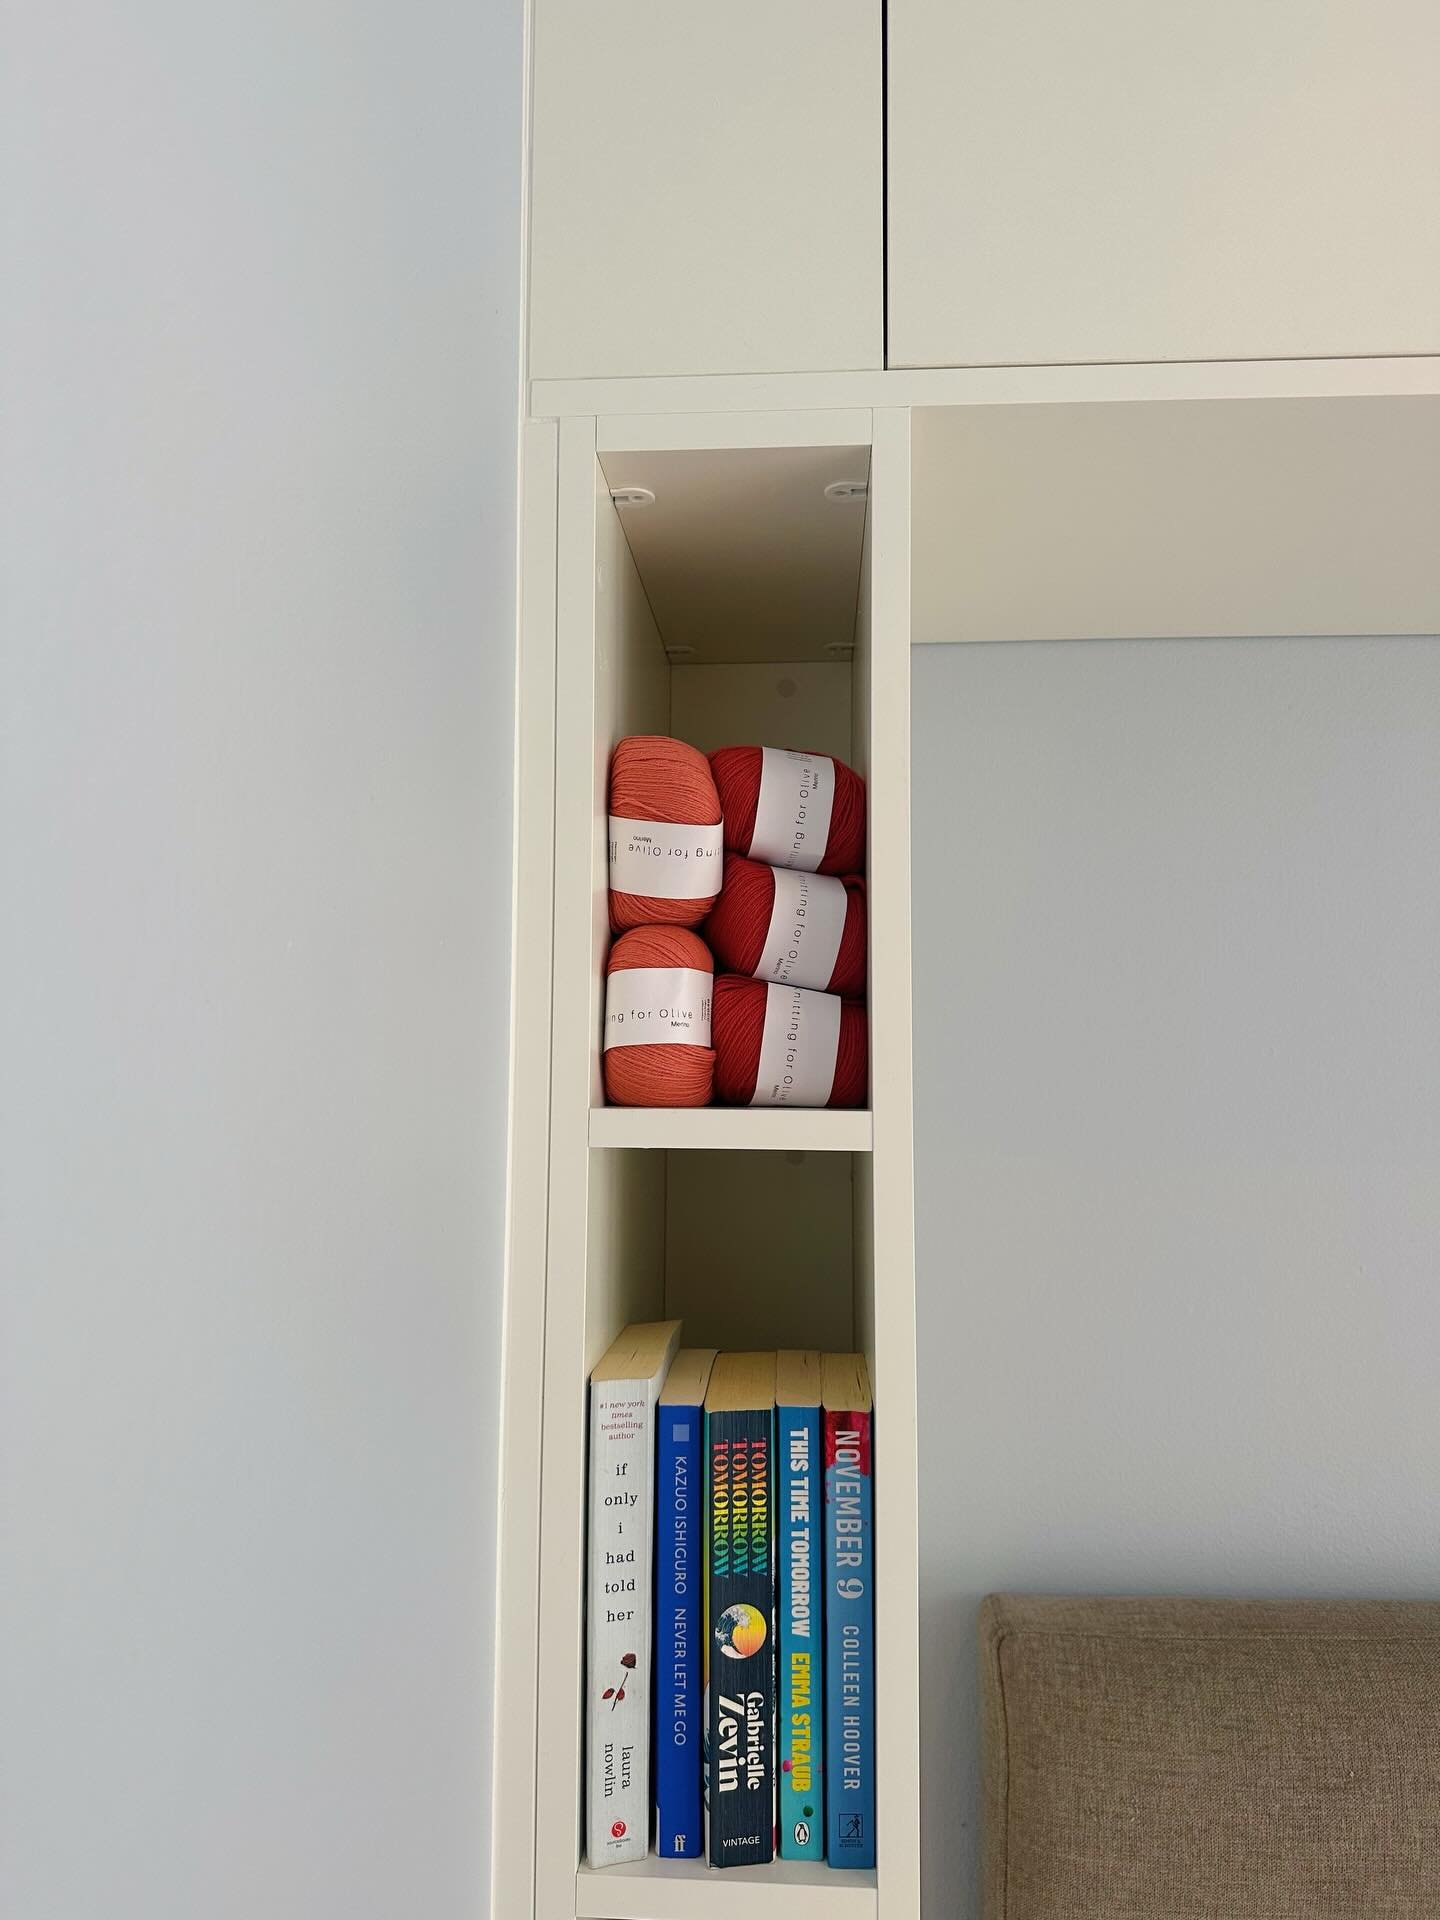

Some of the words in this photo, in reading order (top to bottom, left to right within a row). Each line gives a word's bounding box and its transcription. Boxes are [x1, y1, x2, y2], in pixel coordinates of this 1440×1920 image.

[799, 768, 811, 799] Olive
[795, 804, 807, 825] for
[628, 844, 661, 857] Olive
[633, 835, 652, 844] Merino
[668, 848, 688, 859] for
[794, 923, 805, 945] for
[780, 950, 798, 980] Olive
[631, 1009, 652, 1020] for
[659, 1008, 693, 1019] Olive
[786, 1048, 797, 1070] for
[611, 1411, 633, 1419] times
[627, 1400, 645, 1409] york
[601, 1421, 643, 1431] bestselling
[608, 1432, 635, 1440] author
[790, 1427, 809, 1472] THIS
[616, 1463, 628, 1476] if
[674, 1456, 687, 1511] KAZUO
[604, 1492, 638, 1507] only
[713, 1439, 729, 1579] TOMORROW
[732, 1437, 748, 1577] TOMORROW
[751, 1437, 768, 1576] TOMORROW
[790, 1476, 809, 1523] TIME
[835, 1430, 863, 1567] NOVEMBER
[618, 1522, 623, 1534] i
[606, 1550, 635, 1564] had
[674, 1516, 687, 1594] ISHIGURO
[605, 1579, 635, 1594] told
[791, 1527, 811, 1638] TOMORROW
[836, 1577, 864, 1599] 9
[607, 1610, 634, 1622] her
[674, 1608, 687, 1658] NEVER
[674, 1664, 687, 1690] LET
[843, 1625, 860, 1706] COLLEEN
[791, 1652, 811, 1708] EMMA
[674, 1694, 687, 1717] ME
[674, 1721, 687, 1746] GO
[718, 1693, 746, 1793] Zevin
[746, 1691, 765, 1791] Gabrielle
[791, 1713, 812, 1792] STRAUB
[843, 1716, 861, 1790] HOOVER
[605, 1743, 616, 1797] nowlin
[622, 1746, 634, 1789] laura
[674, 1834, 687, 1852] ff
[722, 1836, 760, 1847] VINTAGE
